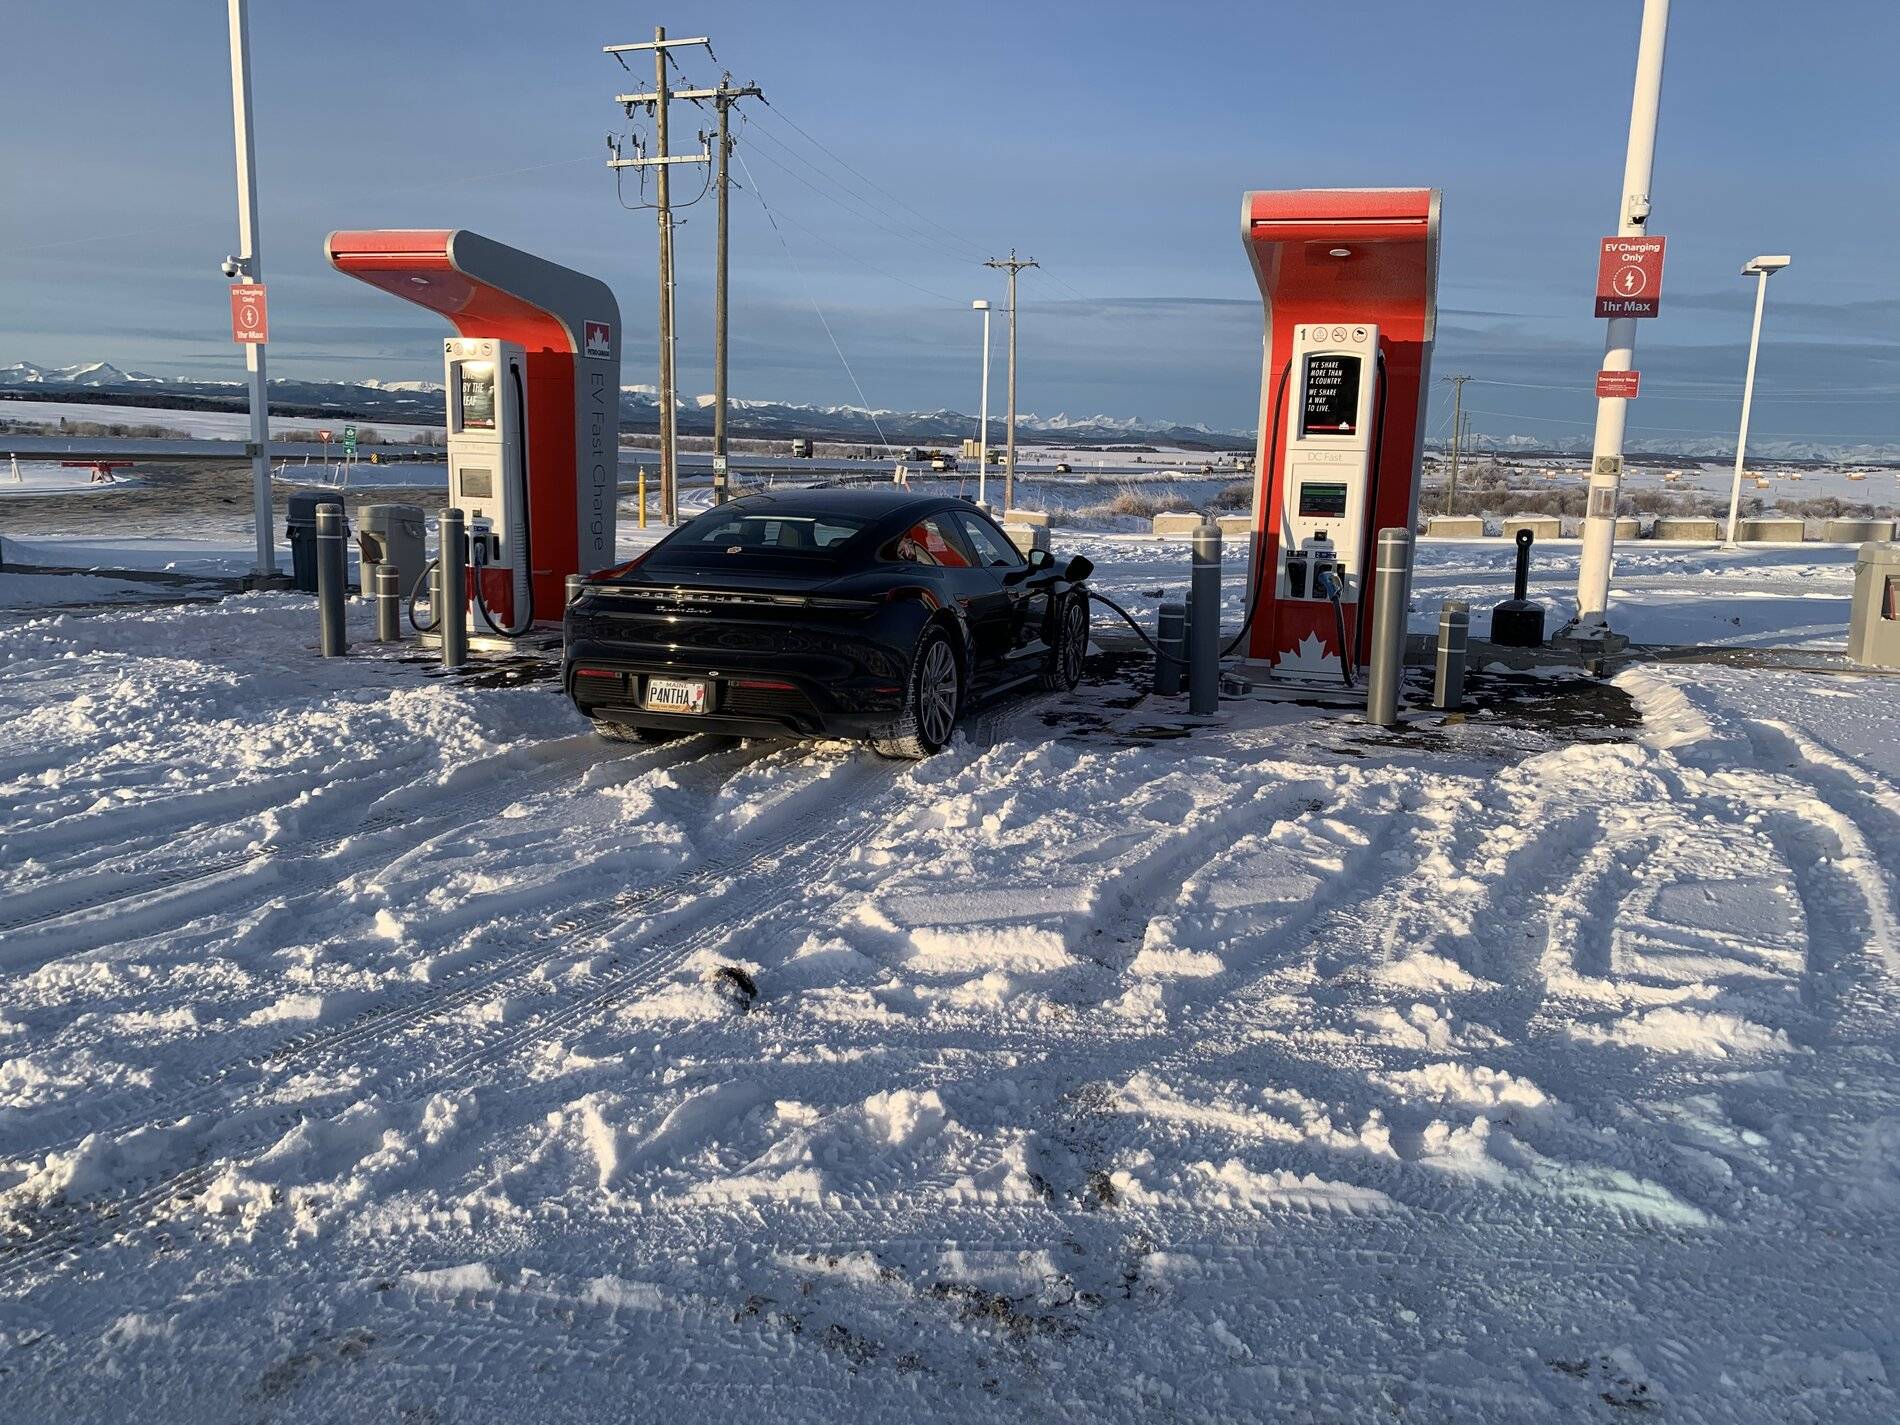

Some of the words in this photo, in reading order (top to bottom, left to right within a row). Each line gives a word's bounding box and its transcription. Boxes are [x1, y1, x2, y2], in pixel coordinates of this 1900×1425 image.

[1605, 244, 1618, 252] EV
[1618, 243, 1660, 253] Charging
[1622, 253, 1644, 262] Only
[1603, 301, 1622, 312] 1hr
[1623, 301, 1651, 312] Max
[248, 331, 265, 339] Max
[1300, 328, 1306, 341] 1
[445, 343, 452, 353] 2
[1310, 361, 1319, 369] WE
[1321, 361, 1339, 369] SHARE
[1310, 369, 1326, 377] MORE
[1328, 369, 1343, 377] THAN
[1315, 377, 1342, 385] COUNTRY.
[463, 382, 473, 393] BY
[473, 382, 485, 393] THE
[591, 373, 605, 405] EV
[1308, 388, 1317, 396] WE
[1319, 388, 1337, 396] SHARE
[463, 395, 478, 406] LEAF
[1314, 396, 1326, 404] WAY
[1307, 404, 1315, 412] TO
[592, 412, 605, 456] Fast
[1308, 452, 1321, 461] DC
[1323, 452, 1343, 461] Fast
[592, 464, 606, 551] Charge
[640, 592, 742, 603] PORSCHE
[650, 687, 689, 704] P4NTHA
